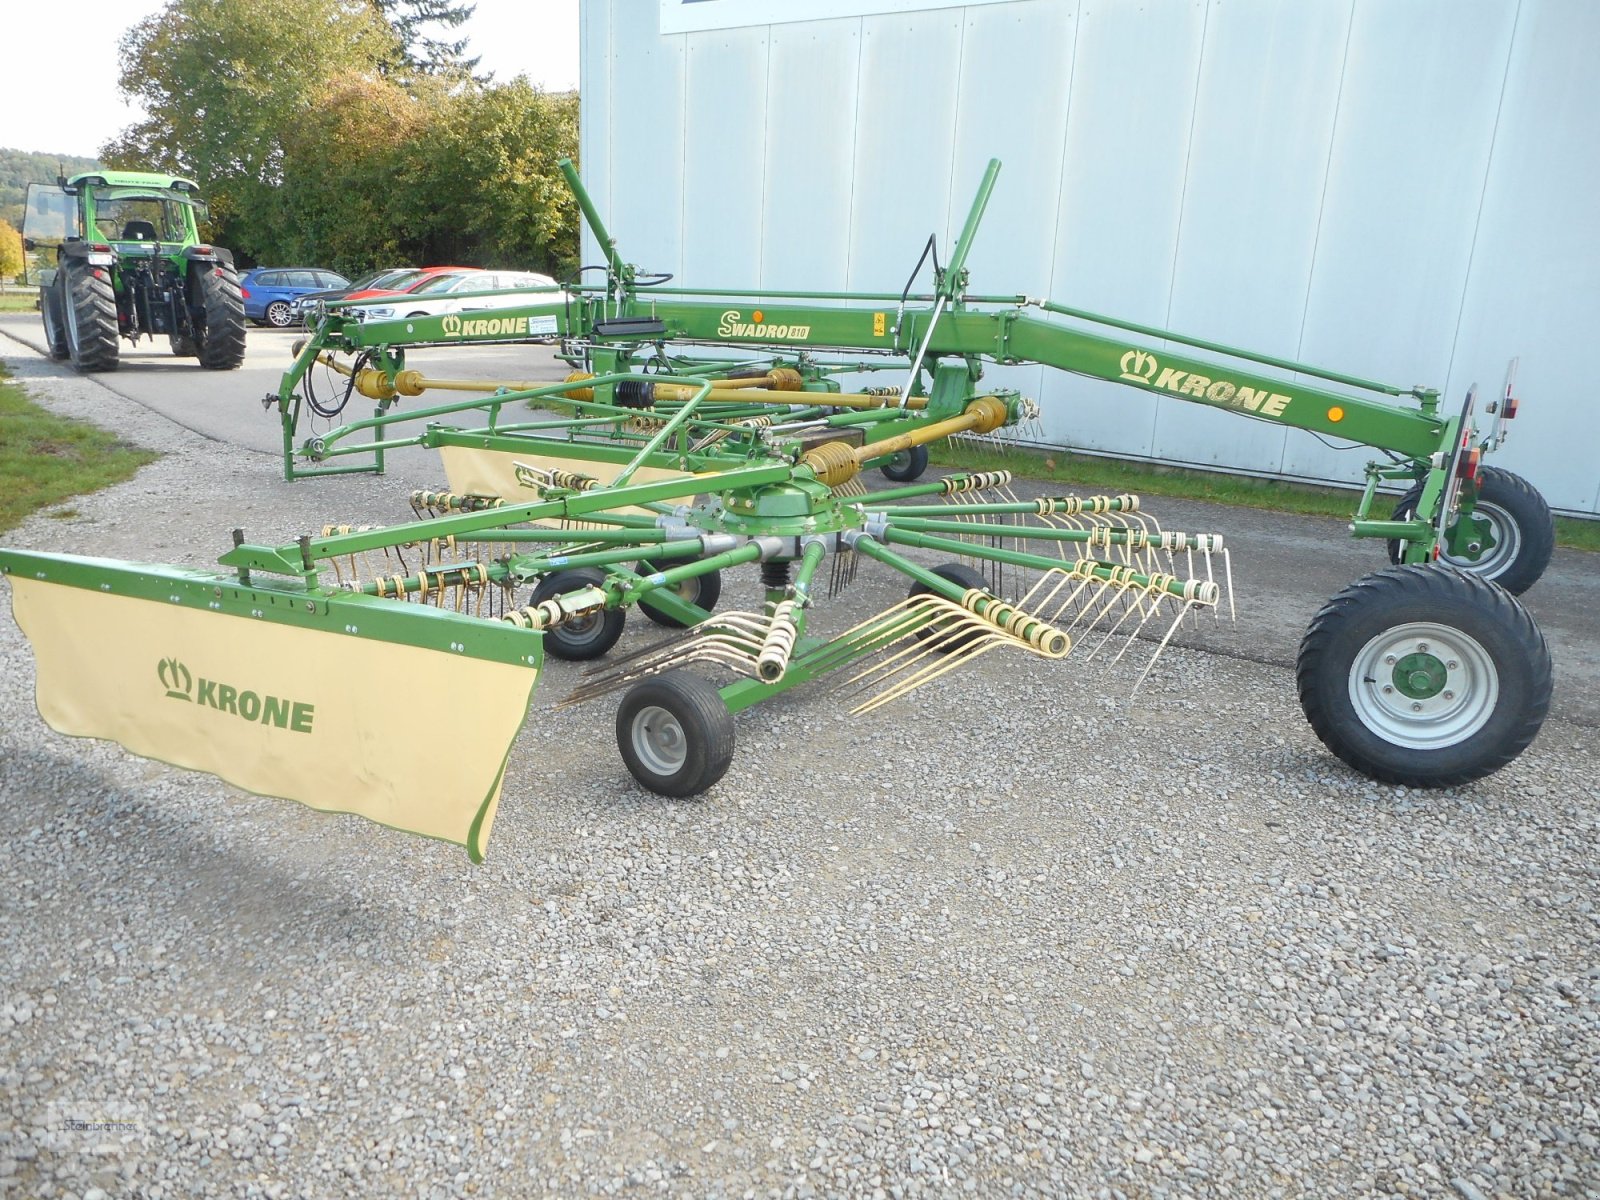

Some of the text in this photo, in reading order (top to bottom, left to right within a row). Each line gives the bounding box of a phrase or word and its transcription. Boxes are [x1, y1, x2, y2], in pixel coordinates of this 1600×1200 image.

[462, 317, 528, 336] KRONE
[717, 310, 808, 339] SWADRO 810
[1154, 367, 1293, 417] KRONE
[197, 677, 315, 734] KRONE
